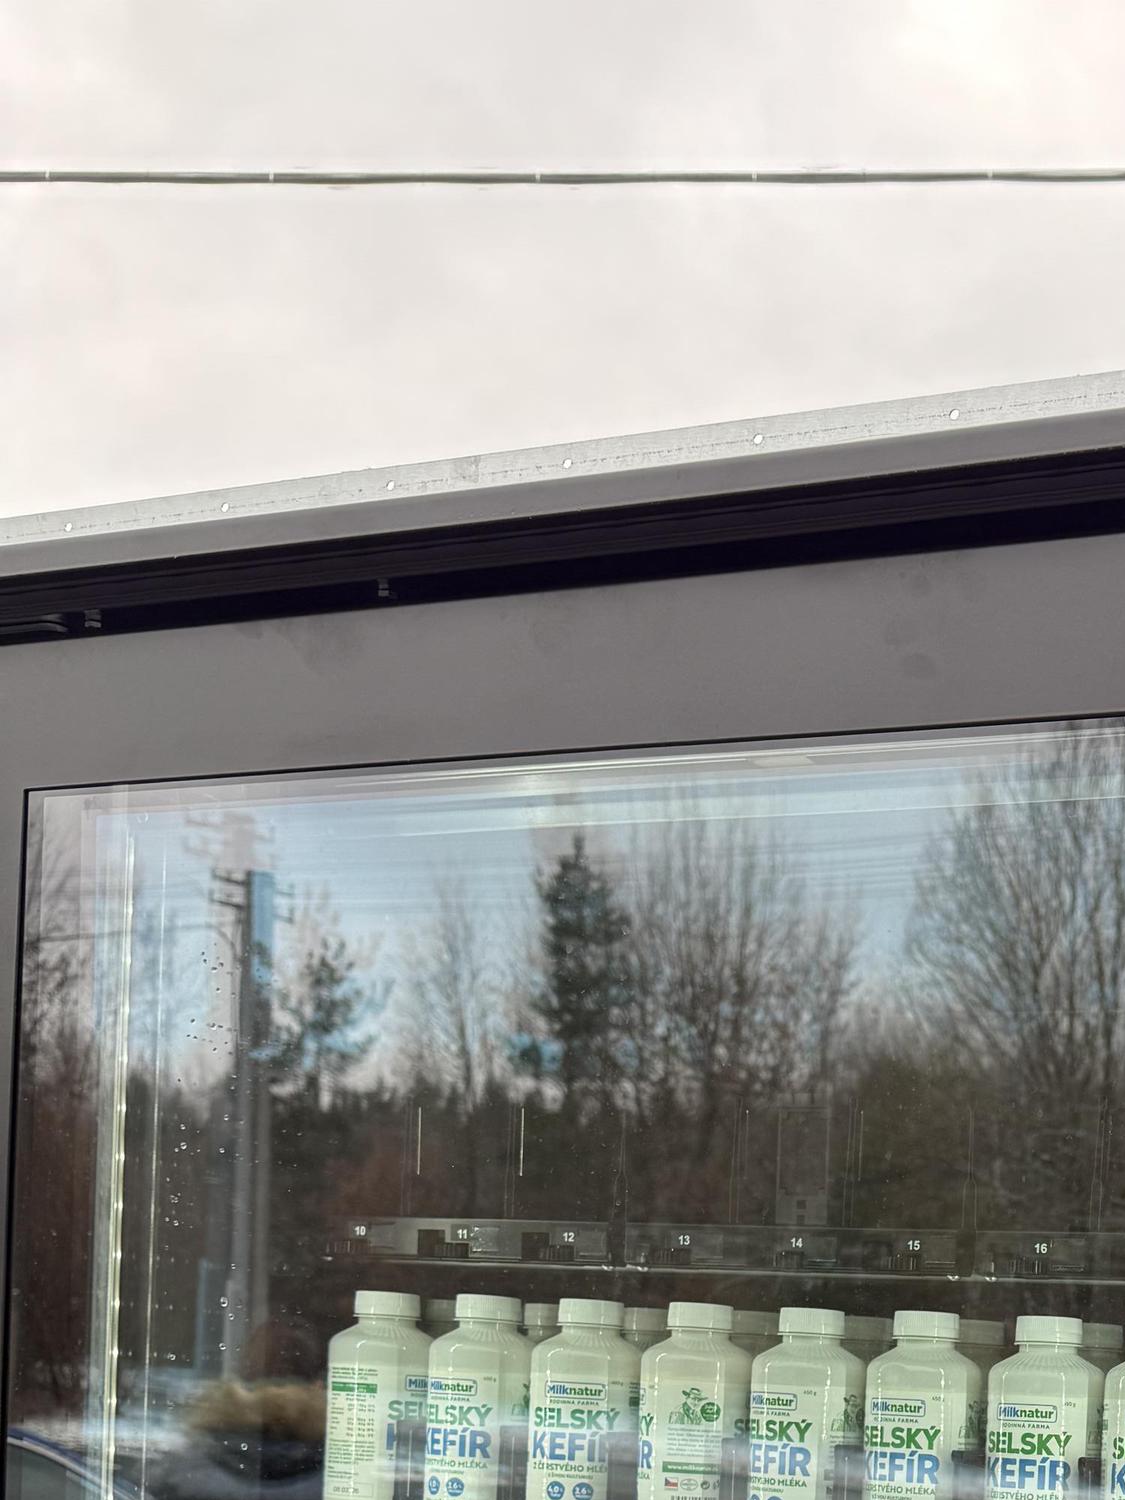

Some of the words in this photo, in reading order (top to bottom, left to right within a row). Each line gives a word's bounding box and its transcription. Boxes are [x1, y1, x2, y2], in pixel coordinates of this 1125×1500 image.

[355, 1226, 365, 1235] 10
[458, 1229, 467, 1238] 11
[563, 1232, 574, 1241] 12
[679, 1235, 689, 1245] 13
[791, 1238, 802, 1247] 14
[908, 1240, 920, 1250] 15
[1035, 1244, 1047, 1253] 16
[999, 1406, 1054, 1419] Milknatur
[988, 1431, 1072, 1456] SELSKÝ
[987, 1456, 1071, 1491] KEFÍR
